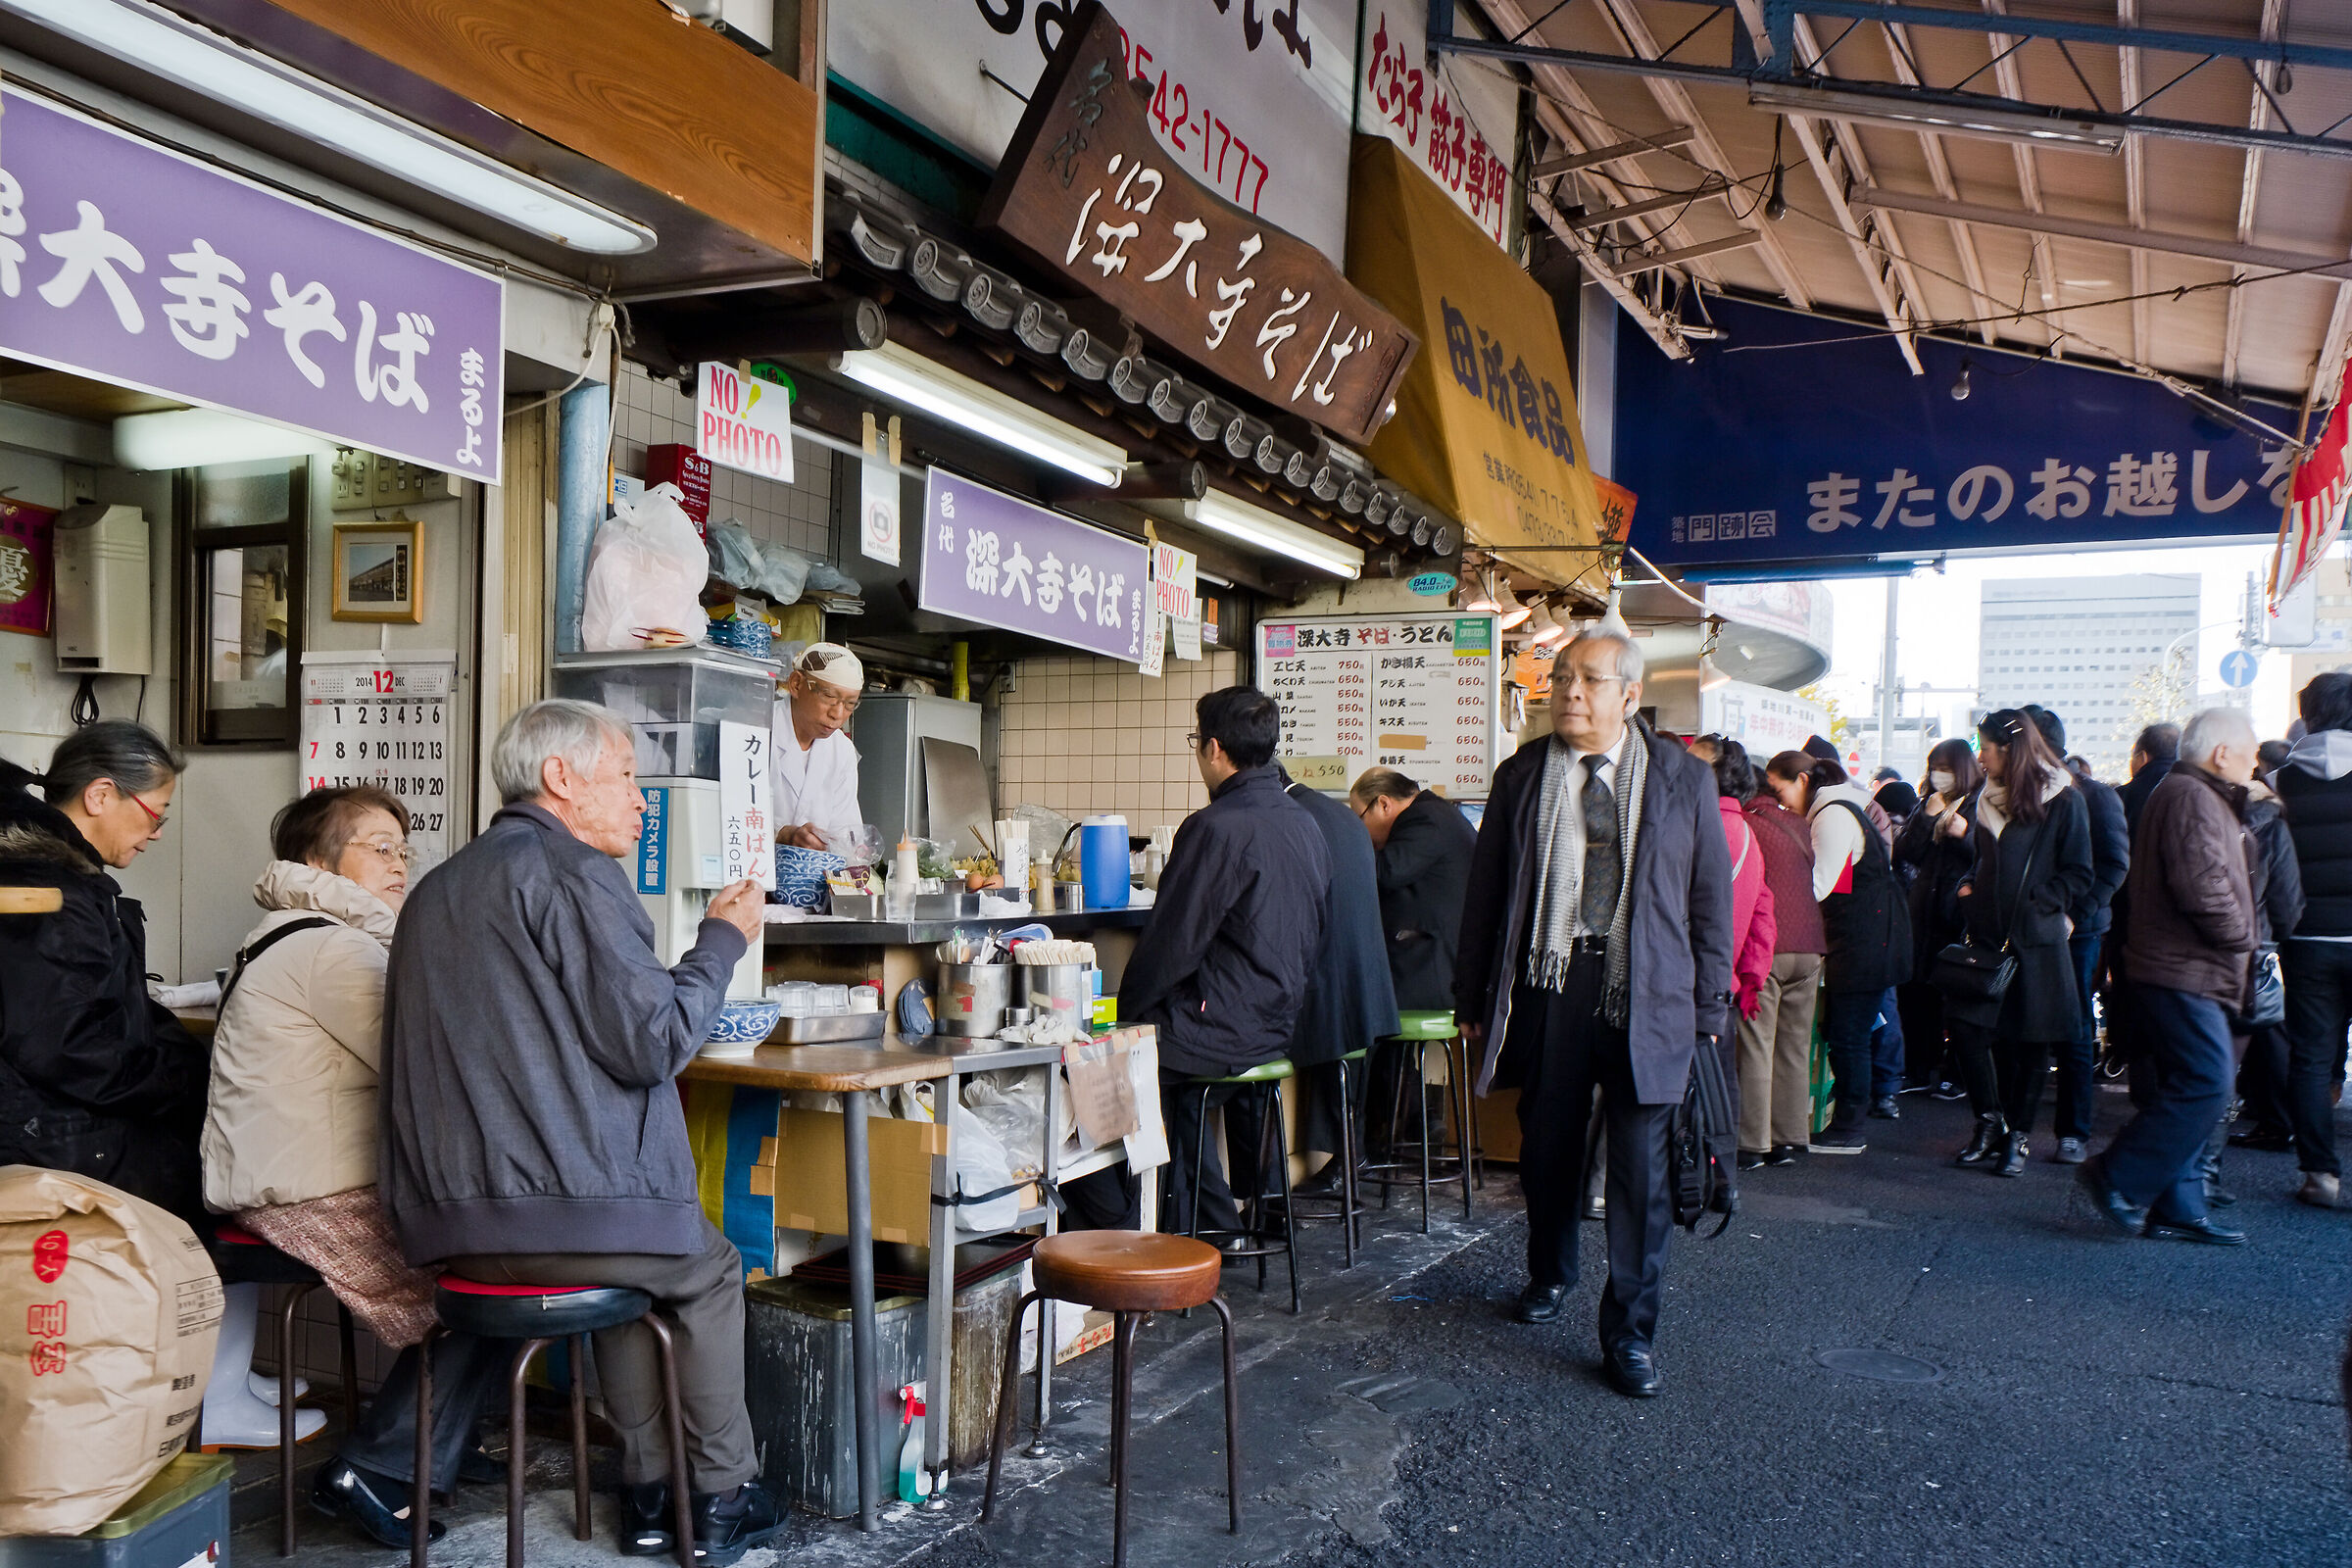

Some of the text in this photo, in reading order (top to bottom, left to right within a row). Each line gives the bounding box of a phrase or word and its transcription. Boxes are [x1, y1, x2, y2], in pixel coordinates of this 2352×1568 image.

[1368, 11, 1507, 245] たら子 筋子専門
[456, 347, 484, 467] まるよ
[703, 410, 783, 476] PHOTO
[938, 491, 956, 554] 名代
[1690, 510, 1776, 542] 門跡会
[965, 527, 1125, 629] 深大寺そば
[1413, 577, 1437, 587] 84.0
[1155, 578, 1190, 619] PHOTO
[1128, 588, 1142, 656] まるよ
[1297, 627, 1351, 649] 深大寺
[355, 677, 372, 687] 2014
[373, 670, 394, 693] 12
[395, 676, 406, 686] DEC
[1280, 706, 1297, 714] カメ
[1379, 698, 1406, 708] いか天
[334, 707, 440, 724] 1 2 3 4 5 6
[1280, 719, 1298, 728] ぬき
[1379, 716, 1405, 727] キス天
[310, 742, 442, 760] 7 8 9 10 11 12 13
[1291, 764, 1346, 778] つね 550
[309, 776, 326, 790] 14
[394, 777, 407, 795] 18
[412, 777, 424, 795] 19
[429, 777, 444, 795] 20
[744, 734, 767, 878] カレー南ばん
[411, 813, 444, 831] 26 27
[645, 790, 662, 886] 防犯カメラ設置
[728, 816, 743, 878] 六五〇円
